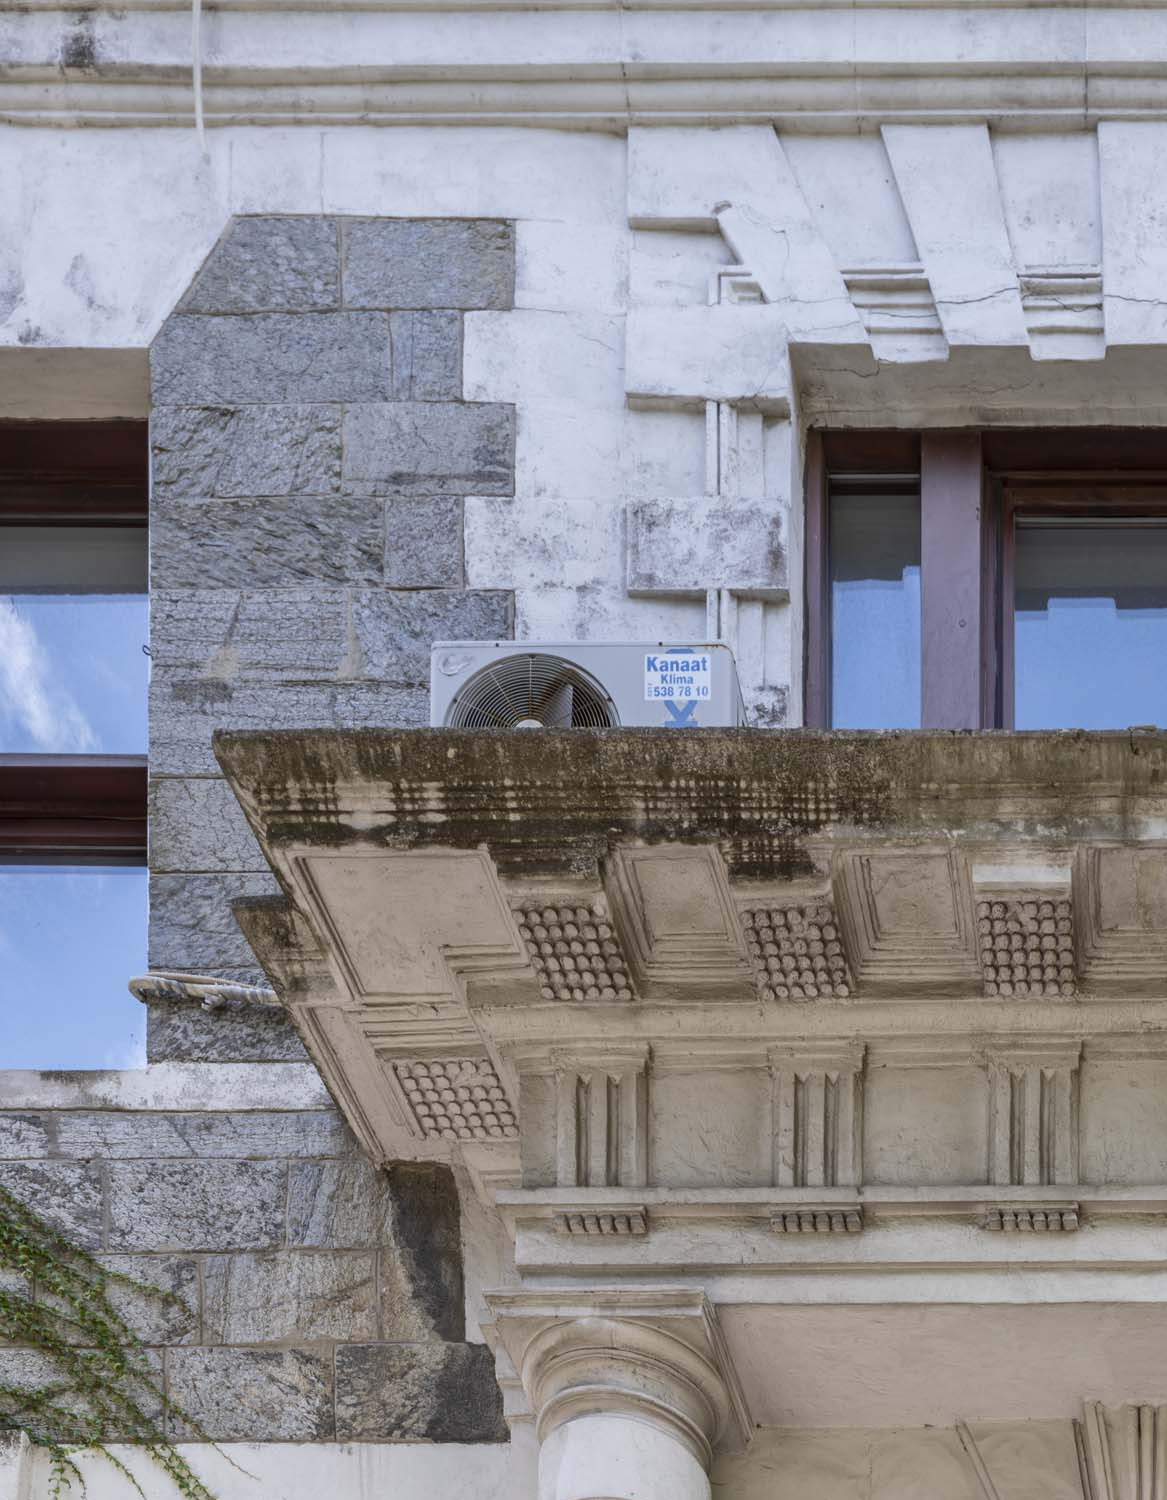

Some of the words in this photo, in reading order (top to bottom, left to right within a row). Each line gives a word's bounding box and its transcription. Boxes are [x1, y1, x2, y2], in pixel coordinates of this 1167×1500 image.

[646, 656, 708, 672] Kanaat
[660, 674, 694, 684] Klima
[653, 686, 674, 697] 538
[679, 686, 691, 697] 78
[696, 686, 708, 697] 10
